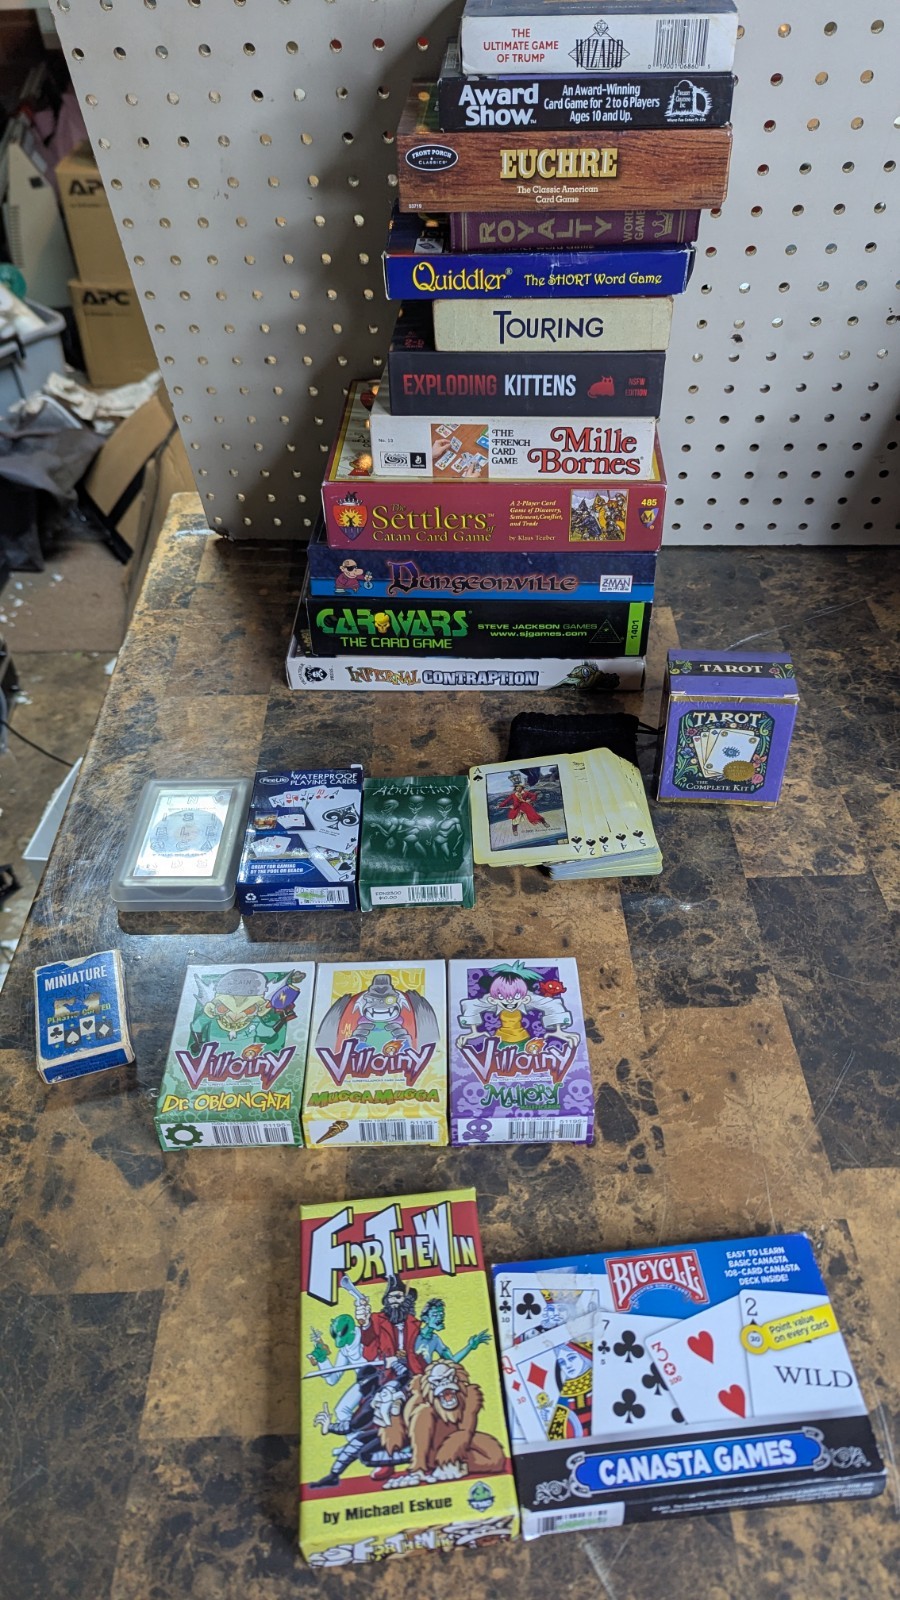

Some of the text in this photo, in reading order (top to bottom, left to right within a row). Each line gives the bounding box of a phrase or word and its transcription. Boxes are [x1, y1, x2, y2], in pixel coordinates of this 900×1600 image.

[511, 28, 531, 38] THE
[483, 40, 559, 51] ULTIMATE GAME
[575, 38, 624, 69] WIZARD
[496, 53, 545, 63] OF TRUMP
[458, 83, 539, 106] Award
[562, 83, 641, 97] An Award-Winning
[543, 97, 660, 111] Card Game for 2 to 6 Players
[569, 110, 633, 124] Ages 10 and Up.
[412, 150, 452, 159] FRONT PORCH
[500, 148, 618, 179] EUCHRE
[517, 185, 599, 194] The Classic American
[535, 195, 580, 203] Card Game
[479, 216, 613, 243] ROYALTY
[524, 274, 545, 288] The
[547, 273, 592, 287] SHORT
[594, 272, 626, 286] Word
[628, 271, 662, 285] Game
[82, 290, 130, 306] APC
[492, 310, 604, 345] TOURING
[403, 374, 577, 396] EXPLODING KITTENS
[491, 429, 514, 438] THE
[550, 427, 638, 454] Mille
[491, 439, 531, 447] FRENCH
[491, 448, 516, 456] CARD
[491, 457, 518, 465] GAME
[527, 448, 641, 475] Bornes
[641, 499, 658, 507] 485
[372, 531, 492, 542] Catan Card Game
[316, 608, 469, 637] CAR WARS
[631, 619, 640, 640] 1401
[490, 630, 587, 638] www.sjgames.com
[340, 637, 453, 649] THE CARD GAME
[422, 669, 540, 686] CONTRAPTION
[700, 664, 763, 674] TAROT
[693, 711, 762, 728] TAROT
[686, 783, 750, 792] COMPLETE KIT
[44, 965, 108, 992] MINIATURE
[175, 1042, 297, 1091] Villainy
[315, 1038, 436, 1087] Villainy
[460, 1036, 578, 1085] Villainy
[194, 1091, 292, 1113] OBLONGATA
[726, 1246, 785, 1259] EASY TO LEARN
[728, 1255, 788, 1268] BASIC CANASTA
[763, 1264, 800, 1274] CANASTA
[612, 1254, 705, 1308] BICYCLE
[739, 1274, 789, 1286] DECK INSIDE!
[500, 1280, 512, 1298] K
[745, 1297, 758, 1316] 2
[601, 1319, 610, 1331] 7
[769, 1315, 815, 1333] Point value
[774, 1320, 829, 1343] on every card
[651, 1341, 669, 1362] 3
[501, 1355, 516, 1375] Q
[774, 1365, 853, 1388] WILD
[598, 1439, 798, 1487] CANASTA GAMES
[323, 1497, 452, 1525] by Michael Eskue
